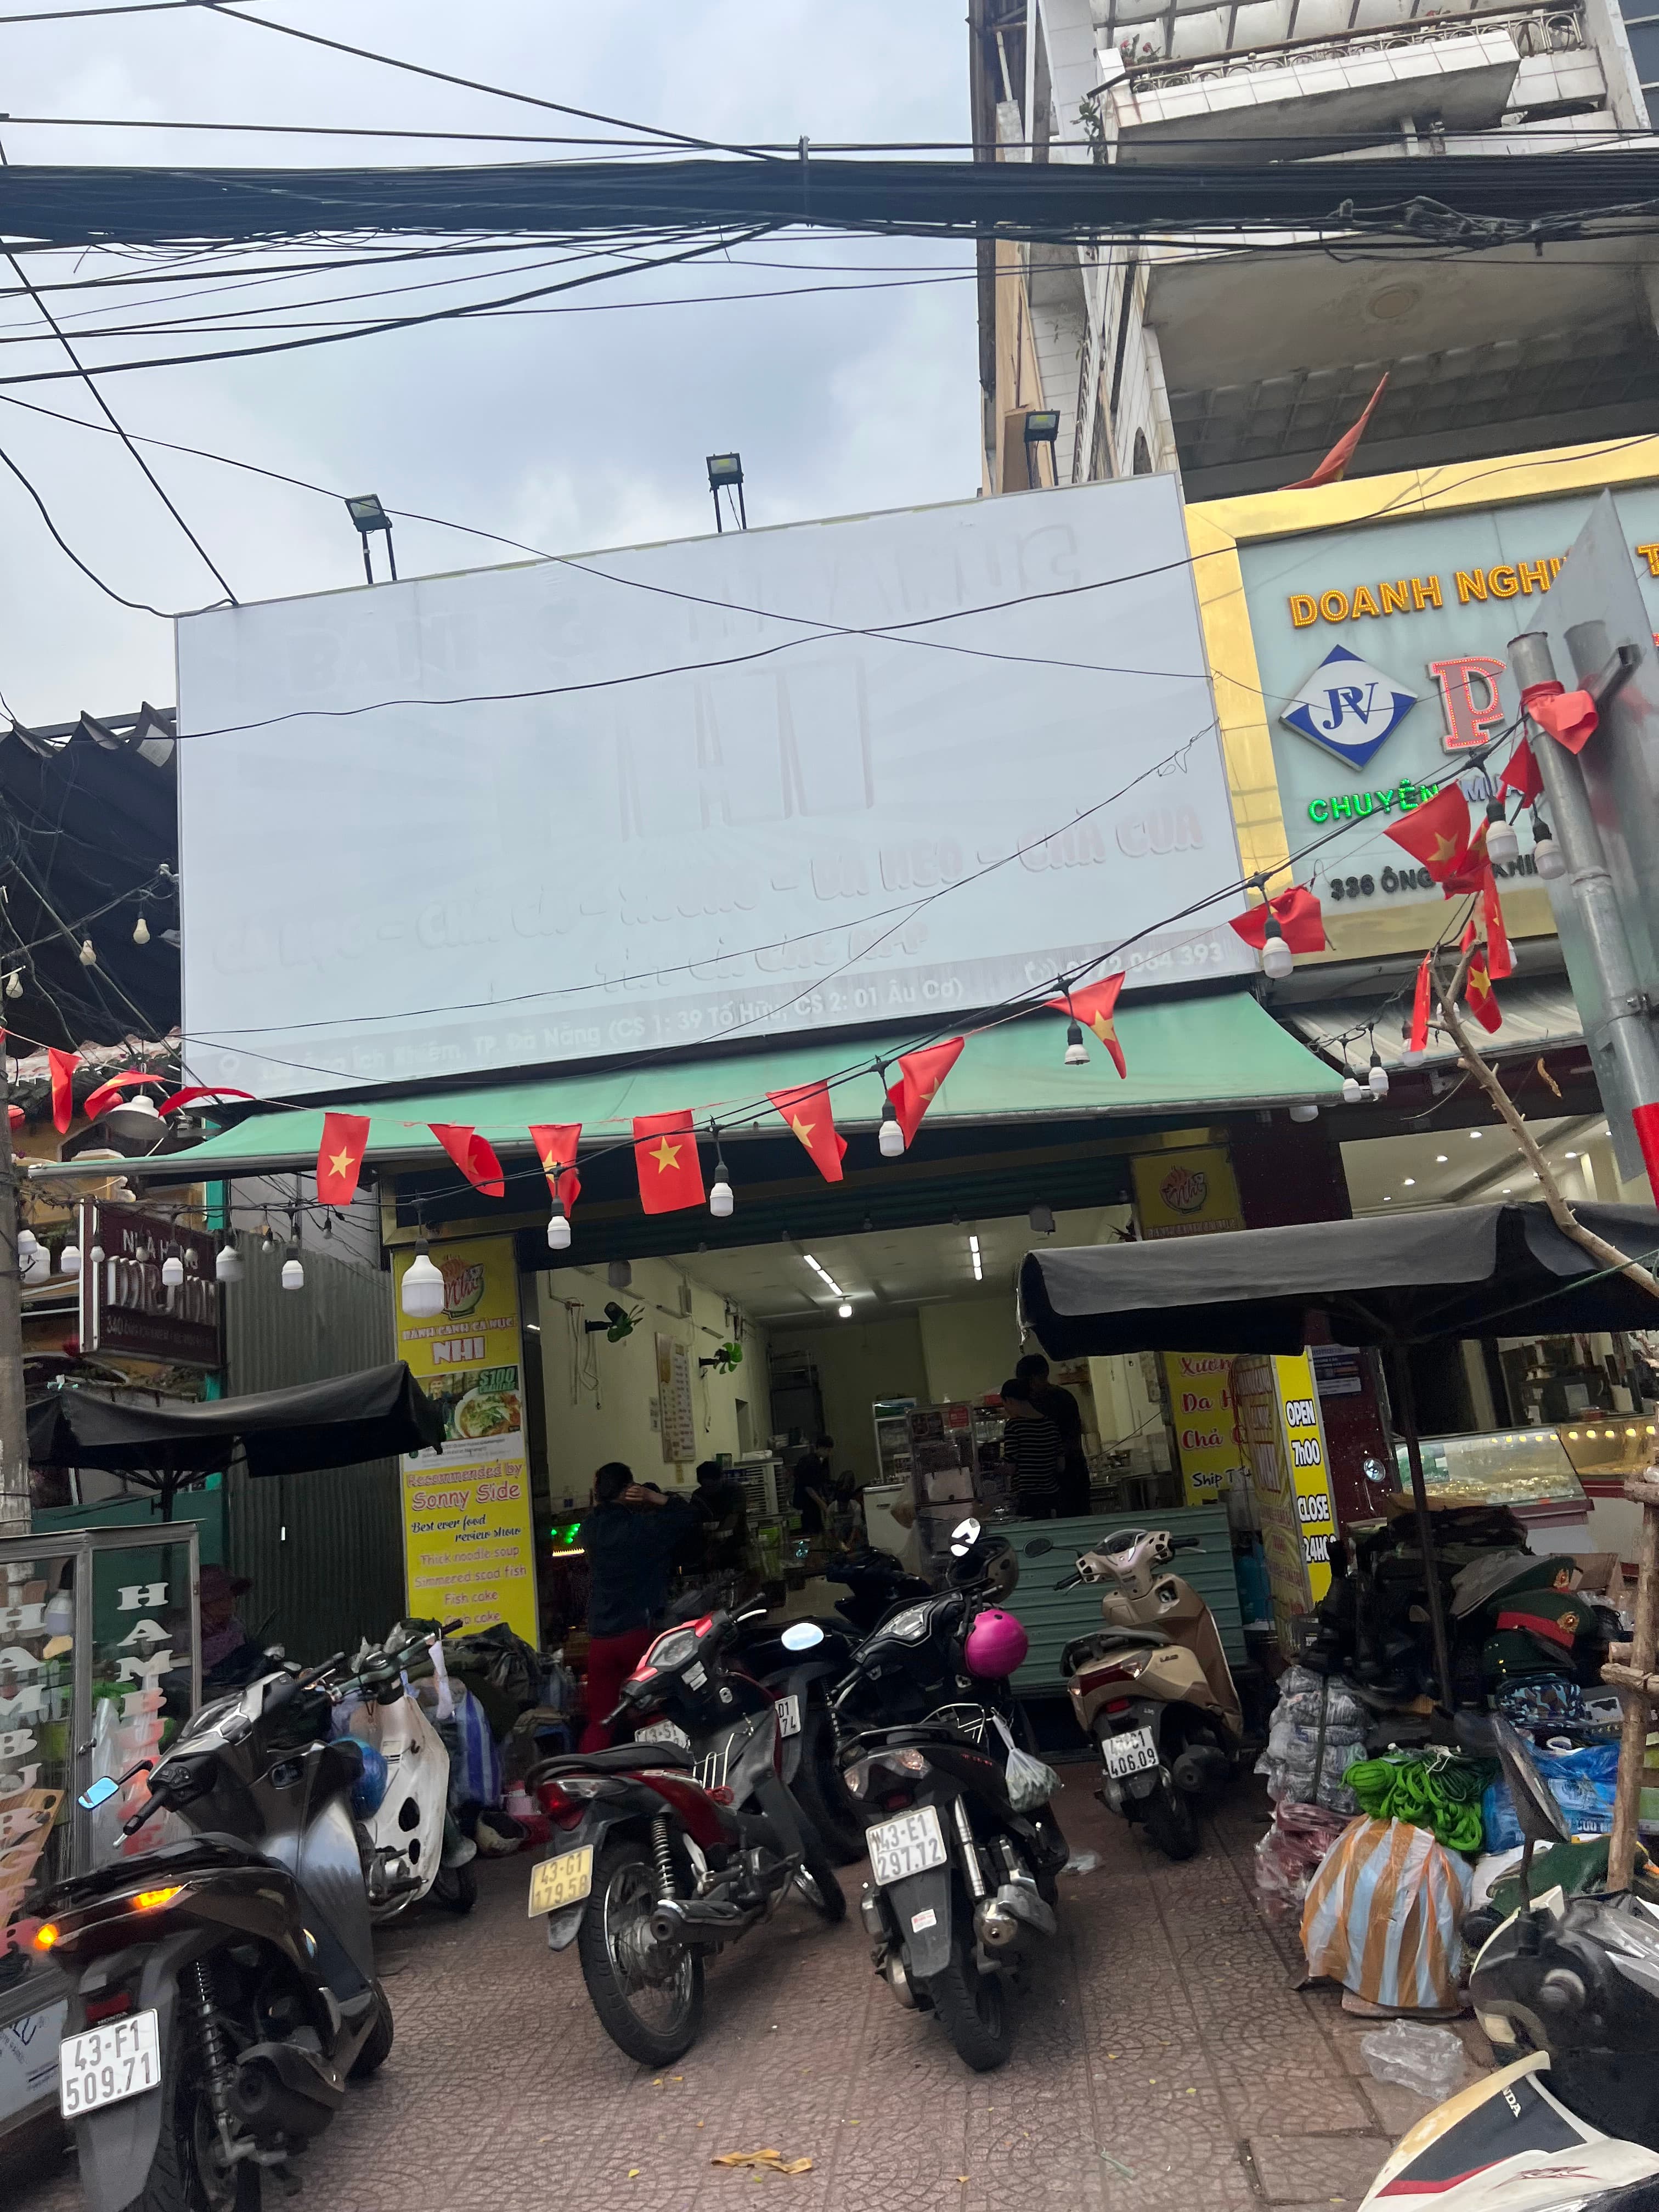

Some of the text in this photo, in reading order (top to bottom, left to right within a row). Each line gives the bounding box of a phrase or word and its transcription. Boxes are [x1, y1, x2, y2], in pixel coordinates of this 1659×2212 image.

[1289, 575, 1443, 628] DOANH
[1178, 941, 1222, 967] 393
[677, 1009, 703, 1031] 39
[794, 994, 822, 1017] CS
[432, 1336, 486, 1365] NHI
[1183, 1393, 1212, 1414] Da
[1285, 1399, 1317, 1426] OPEN
[1182, 1428, 1223, 1451] Chả
[1291, 1438, 1321, 1466] 7h00
[408, 1462, 523, 1488] Recommended by
[1193, 1471, 1223, 1488] Ship
[412, 1480, 522, 1511] Sonny Side
[1297, 1494, 1330, 1522] CLOSE
[411, 1514, 487, 1533] Best ever food
[455, 1526, 522, 1543] review show
[420, 1545, 520, 1567] Thick noodle soup
[415, 1565, 527, 1588] Simmered scad fish
[444, 1589, 499, 1605] Fish cake
[474, 1610, 501, 1623] cake
[1110, 1748, 1156, 1776] 406.09
[880, 1814, 927, 1850] 43-E1
[877, 1837, 941, 1880] 297.72
[75, 2019, 139, 2070] 43-F1
[66, 2052, 150, 2111] 509.71
